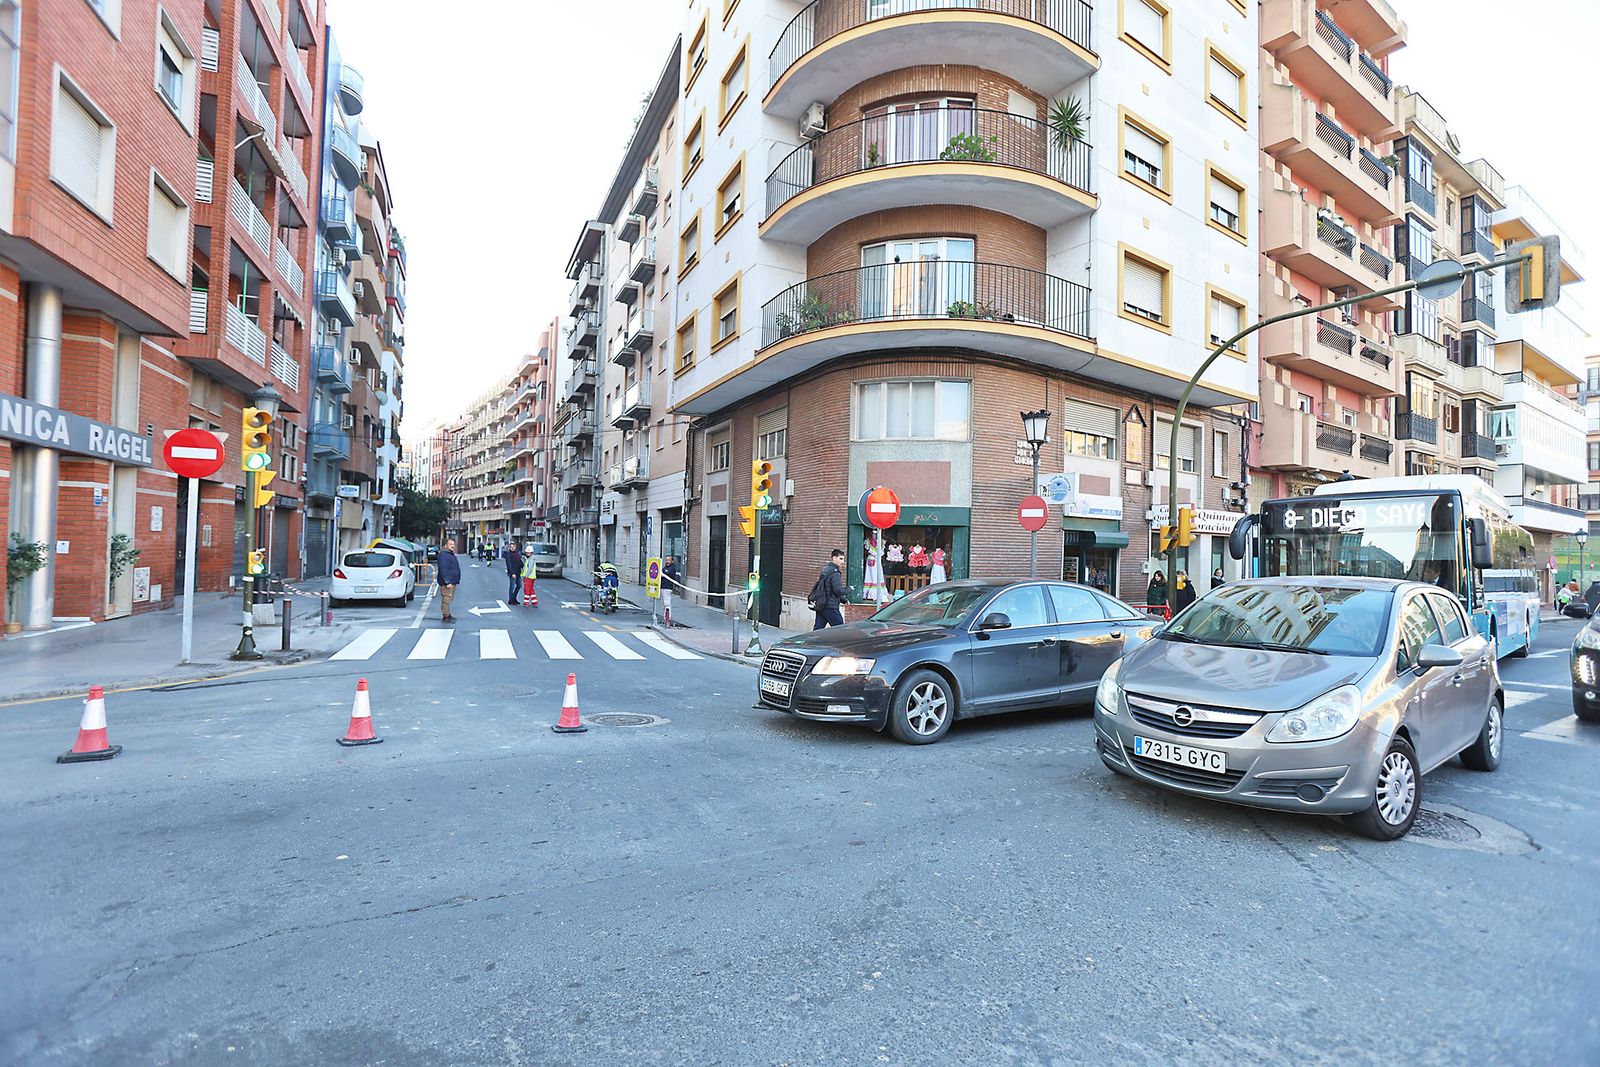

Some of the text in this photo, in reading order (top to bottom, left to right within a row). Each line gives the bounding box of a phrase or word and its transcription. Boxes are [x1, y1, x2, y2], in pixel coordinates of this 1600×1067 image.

[1, 398, 152, 464] NICA RAGEL
[1311, 506, 1368, 528] DIEGO
[1144, 740, 1220, 769] 7315 GYC
